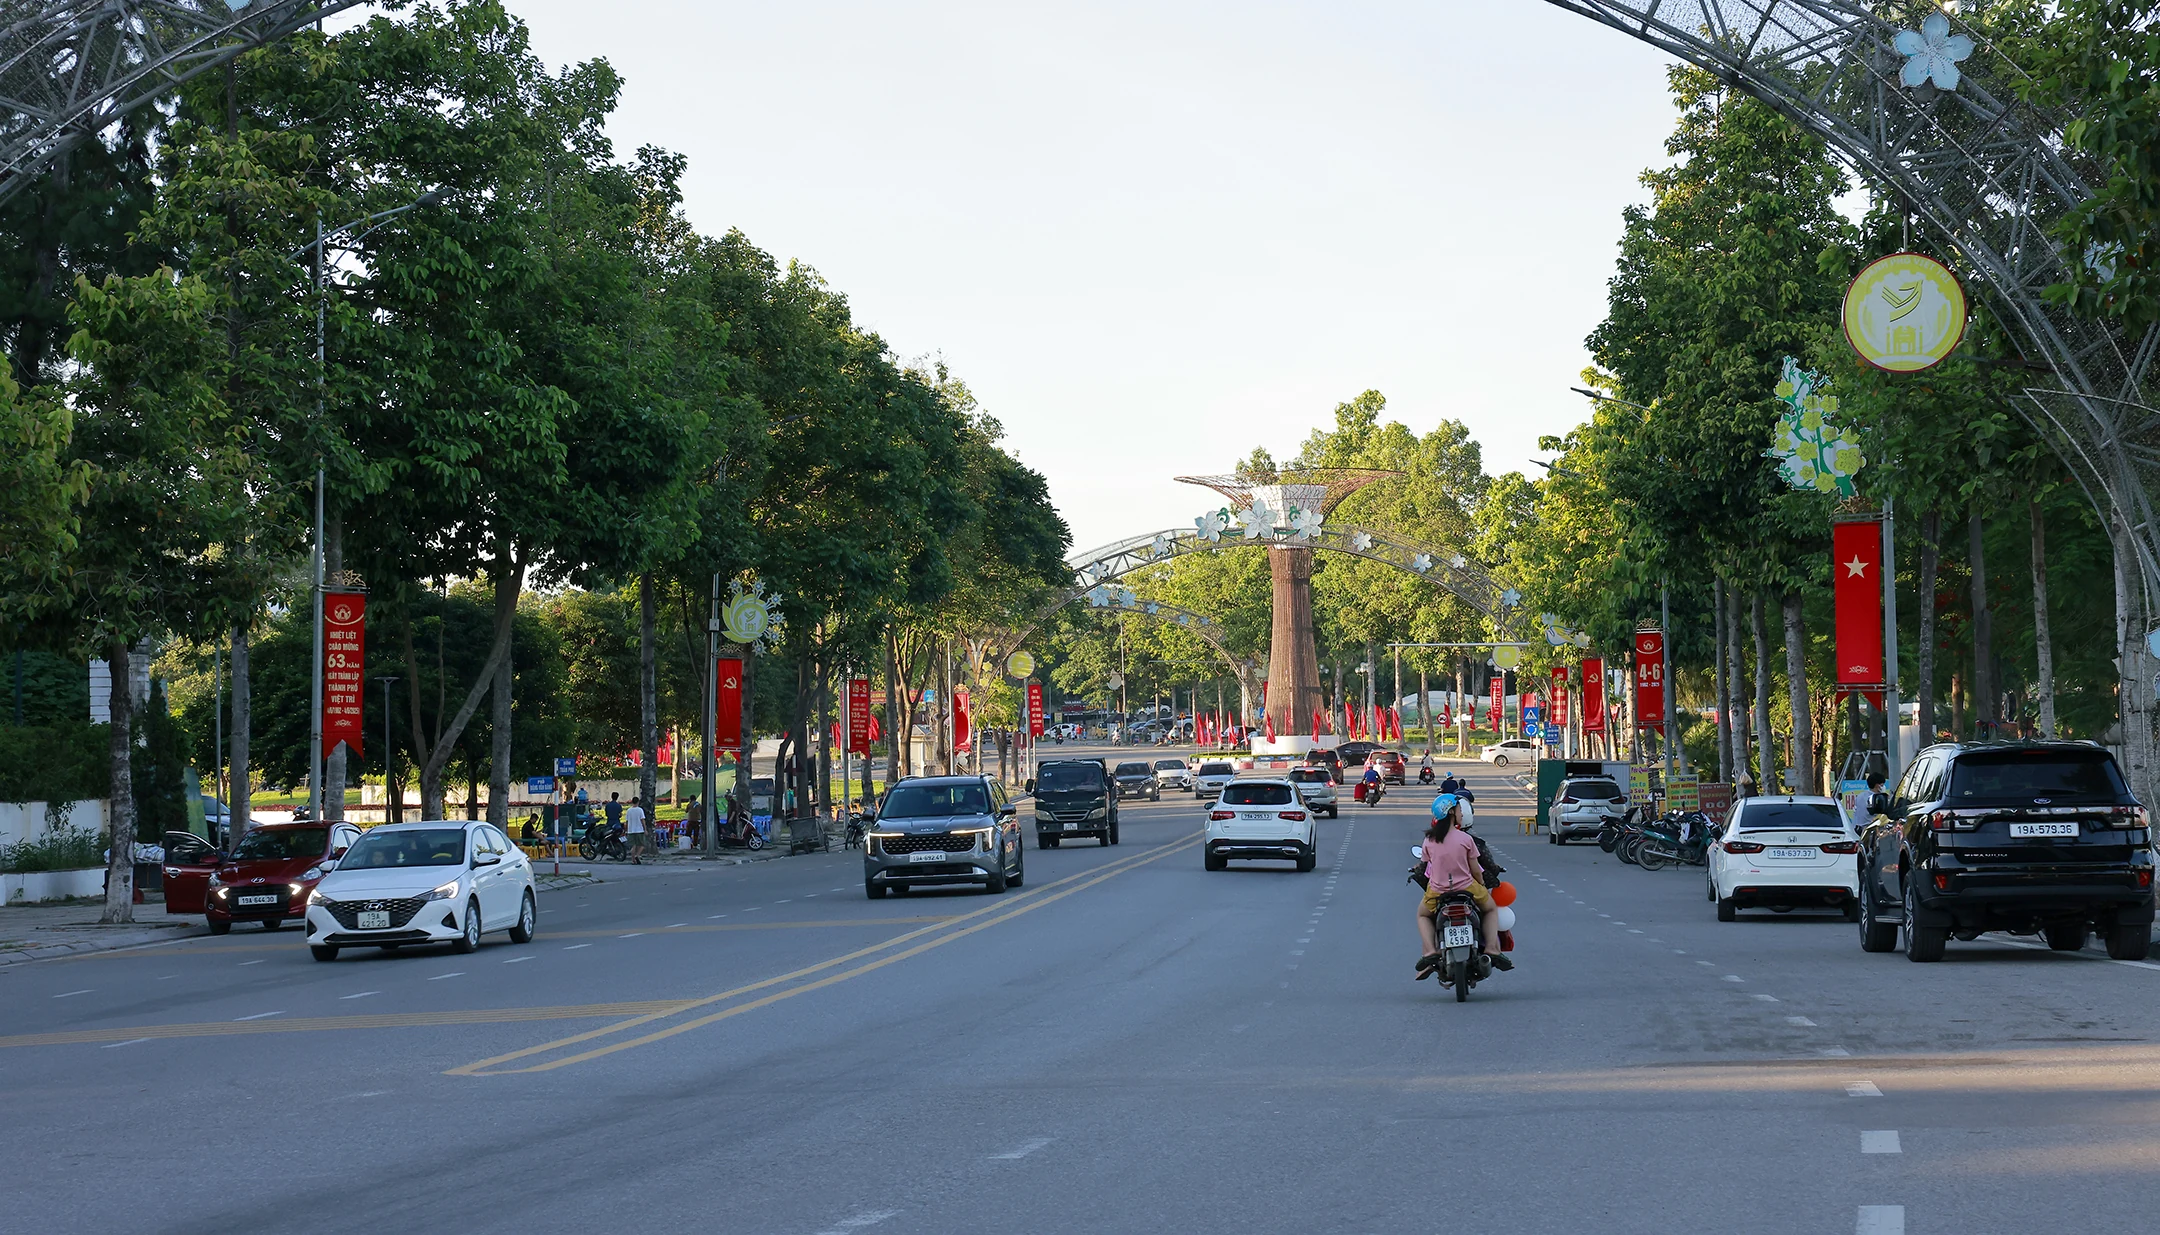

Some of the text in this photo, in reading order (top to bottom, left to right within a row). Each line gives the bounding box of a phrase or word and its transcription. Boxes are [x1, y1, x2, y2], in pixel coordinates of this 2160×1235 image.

[328, 653, 346, 668] 63
[1640, 663, 1660, 680] 4-6
[331, 694, 344, 704] VIỆT
[2017, 825, 2072, 835] 19A-579.36
